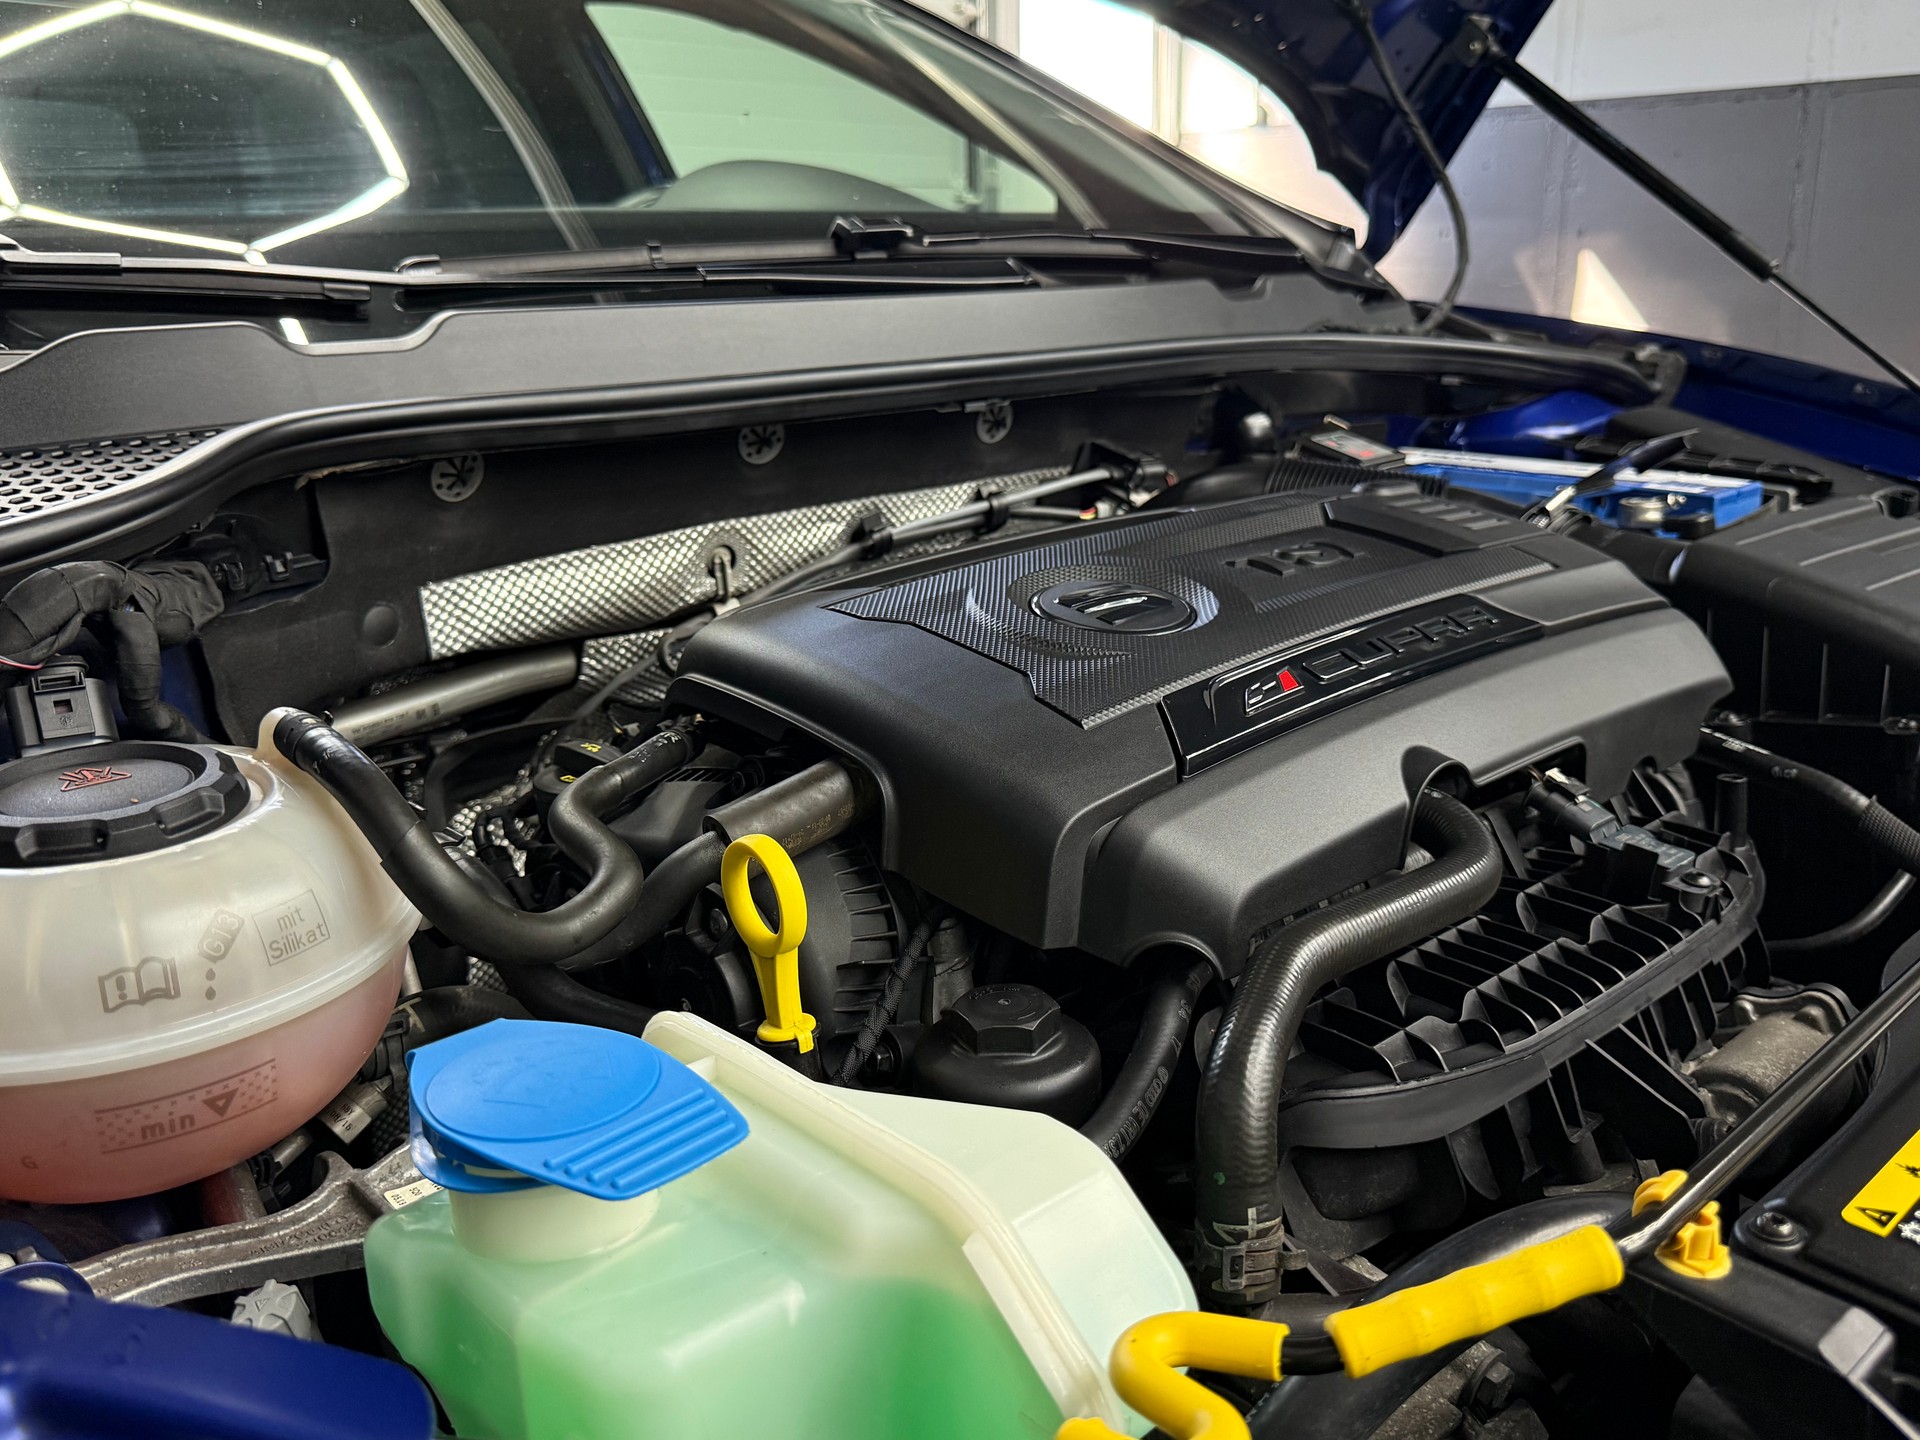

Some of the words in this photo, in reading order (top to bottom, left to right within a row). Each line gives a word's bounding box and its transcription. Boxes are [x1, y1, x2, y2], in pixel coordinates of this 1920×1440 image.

[1302, 605, 1498, 684] CUPRA
[203, 914, 239, 957] G13
[277, 906, 305, 932] mit
[269, 922, 326, 959] Silikat
[141, 1111, 195, 1140] min
